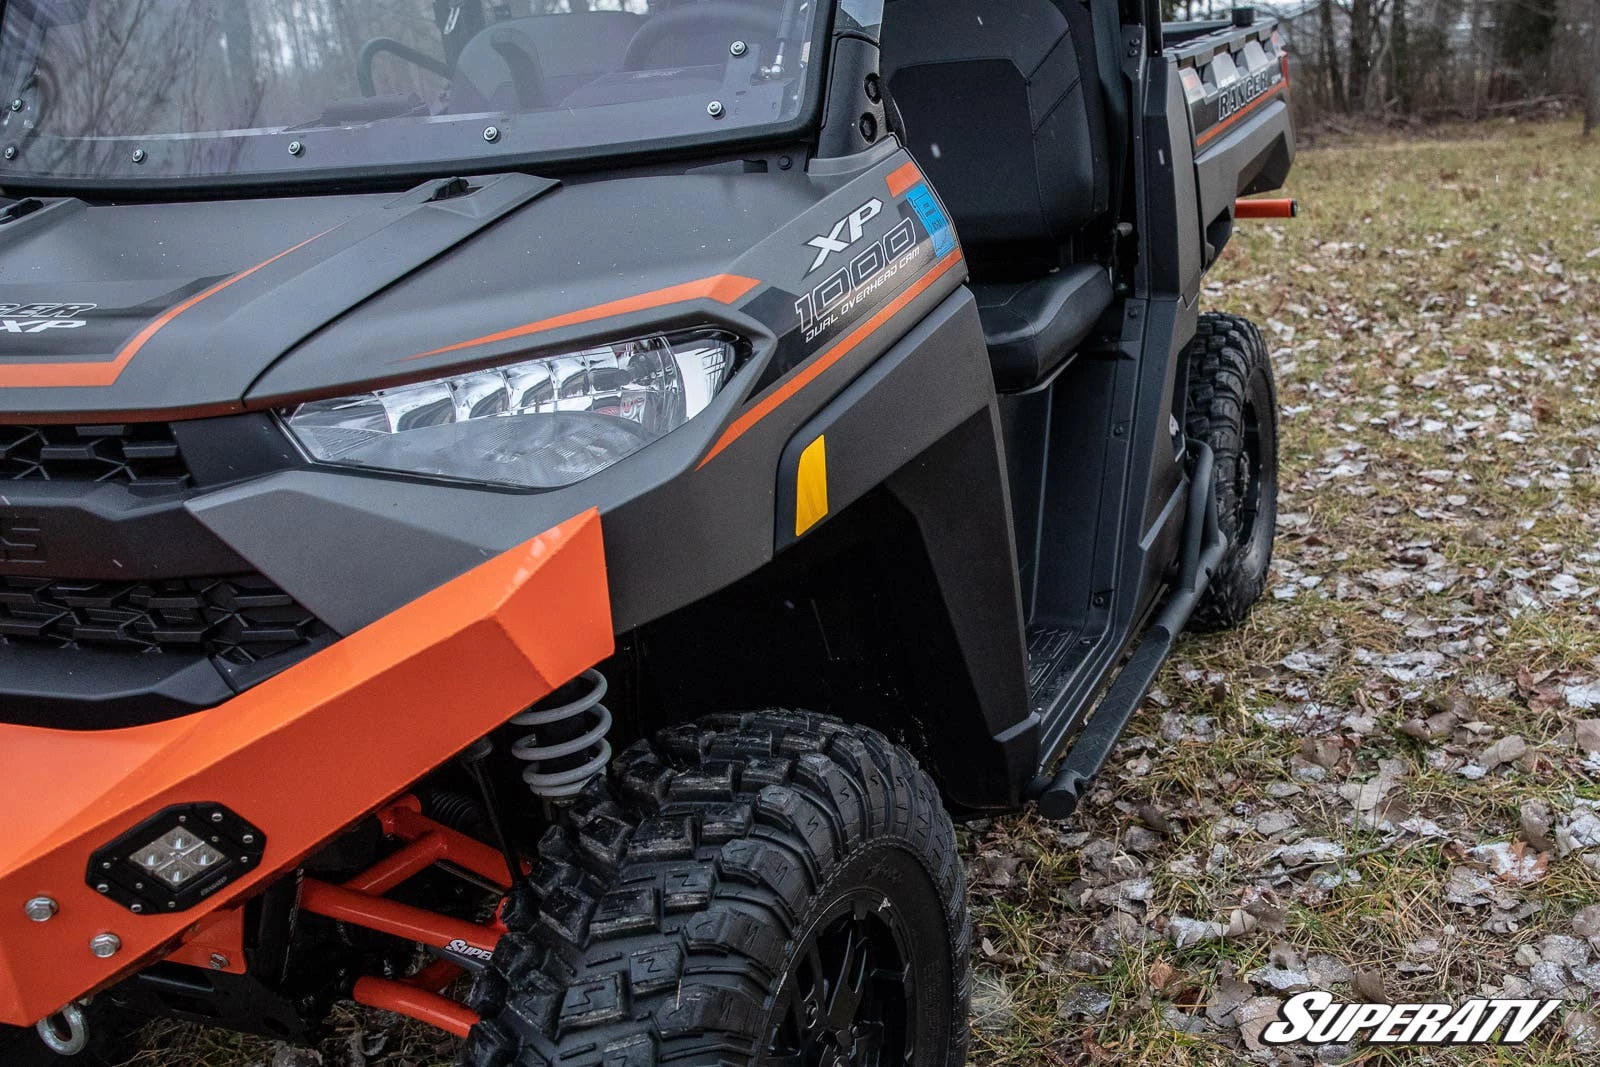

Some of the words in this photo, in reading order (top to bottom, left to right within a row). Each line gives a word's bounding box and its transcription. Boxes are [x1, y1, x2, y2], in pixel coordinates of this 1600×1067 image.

[1218, 68, 1268, 122] RANGER
[795, 217, 916, 333] 1000
[806, 198, 884, 273] XP
[805, 313, 839, 343] DUAL
[841, 265, 898, 315] OVERHEAD
[899, 246, 920, 270] CAM
